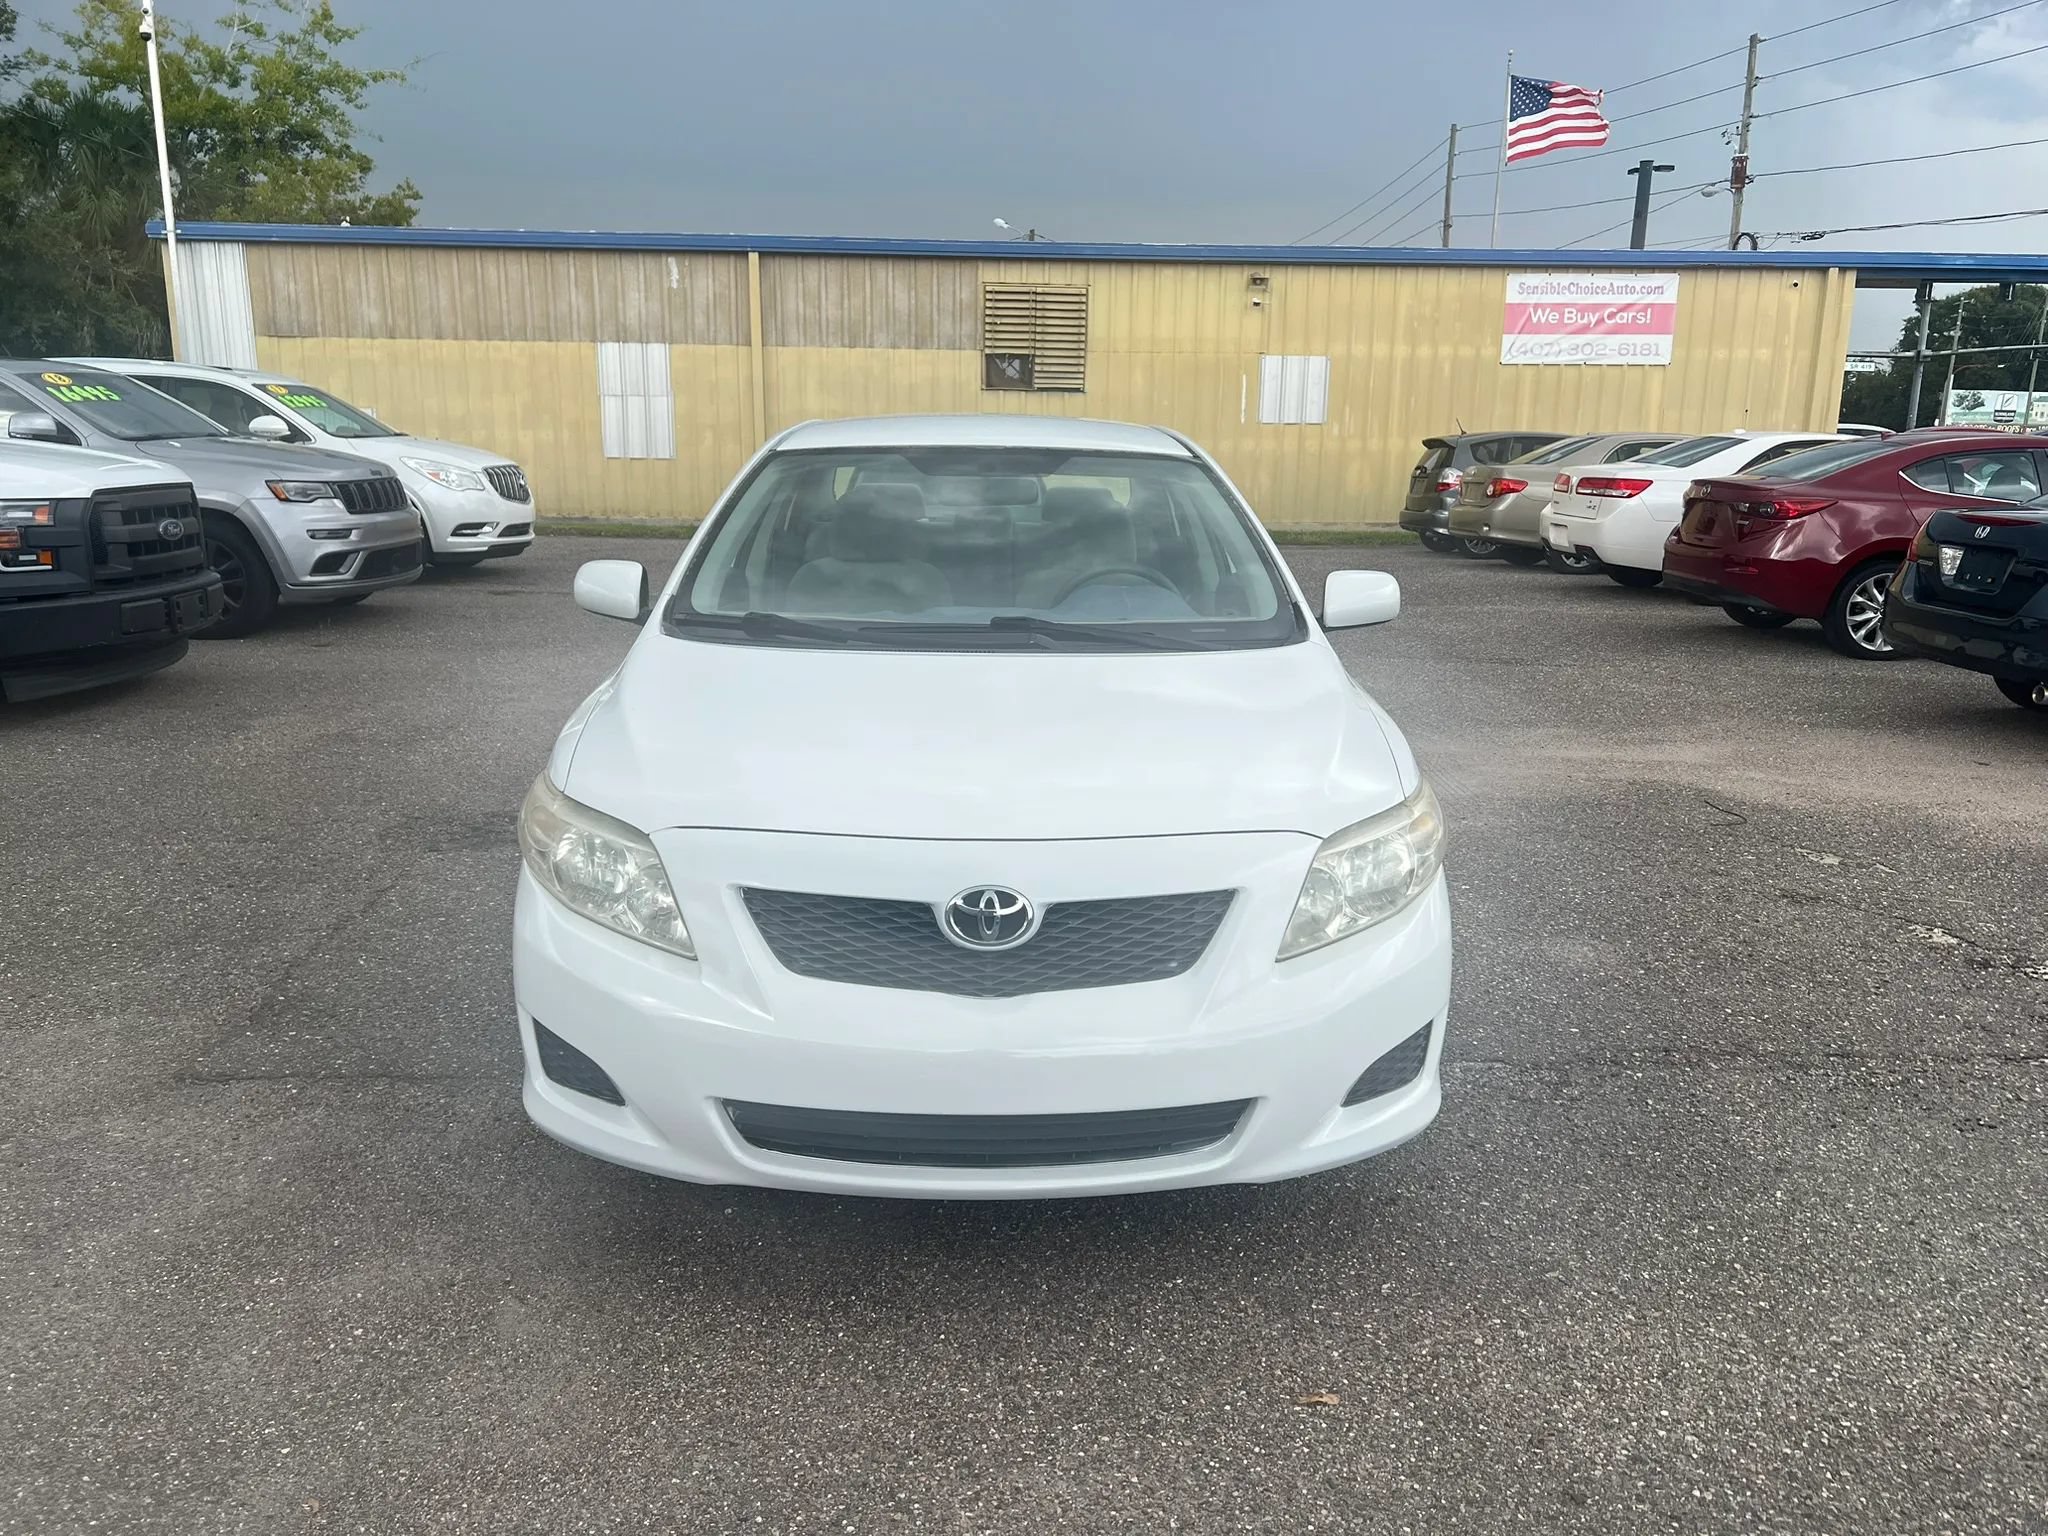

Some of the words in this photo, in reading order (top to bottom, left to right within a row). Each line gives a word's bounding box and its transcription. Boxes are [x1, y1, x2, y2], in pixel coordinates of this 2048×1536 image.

[1518, 282, 1665, 296] SensibleChoiceAuto.com
[1530, 307, 1560, 324] We
[1564, 307, 1600, 328] Buy
[1604, 307, 1652, 324] Cars!
[1566, 342, 1661, 358] 302-6181
